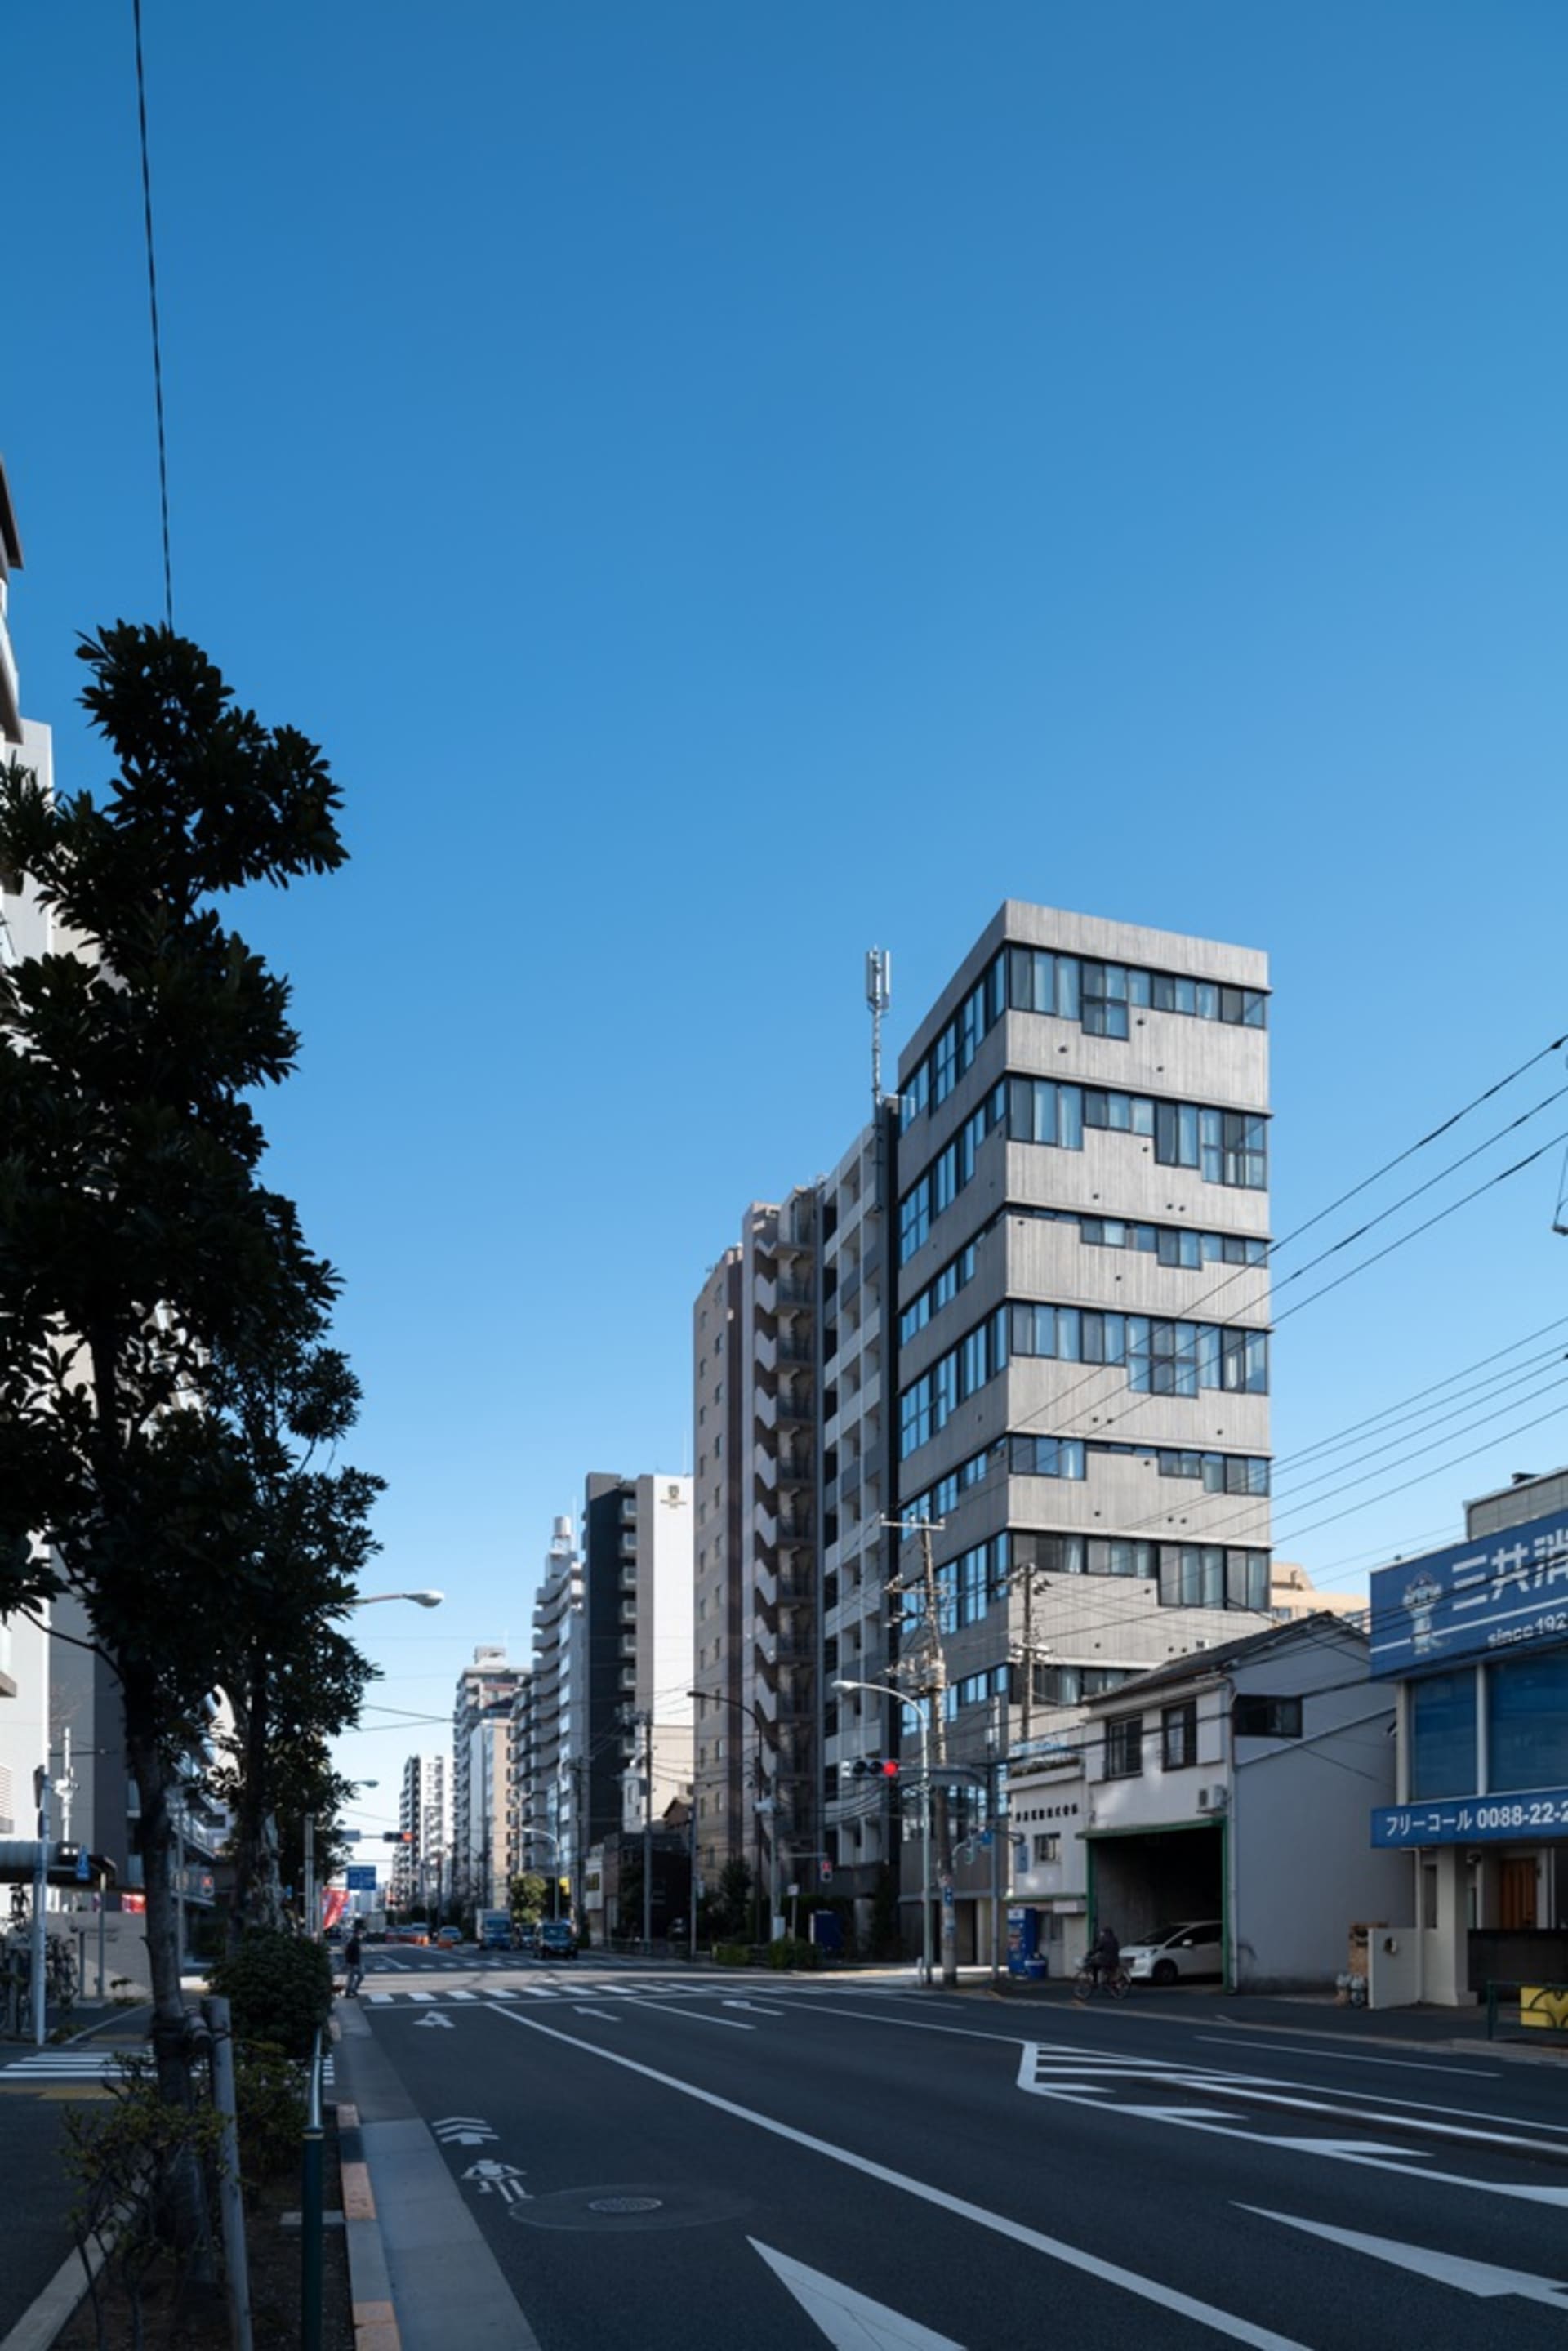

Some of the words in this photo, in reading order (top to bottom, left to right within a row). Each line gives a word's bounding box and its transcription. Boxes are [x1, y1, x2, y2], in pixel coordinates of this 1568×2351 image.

[1452, 1528, 1568, 1611] 三共消
[1386, 1809, 1472, 1837] フリーコール
[1477, 1800, 1568, 1829] 0088-22-2
